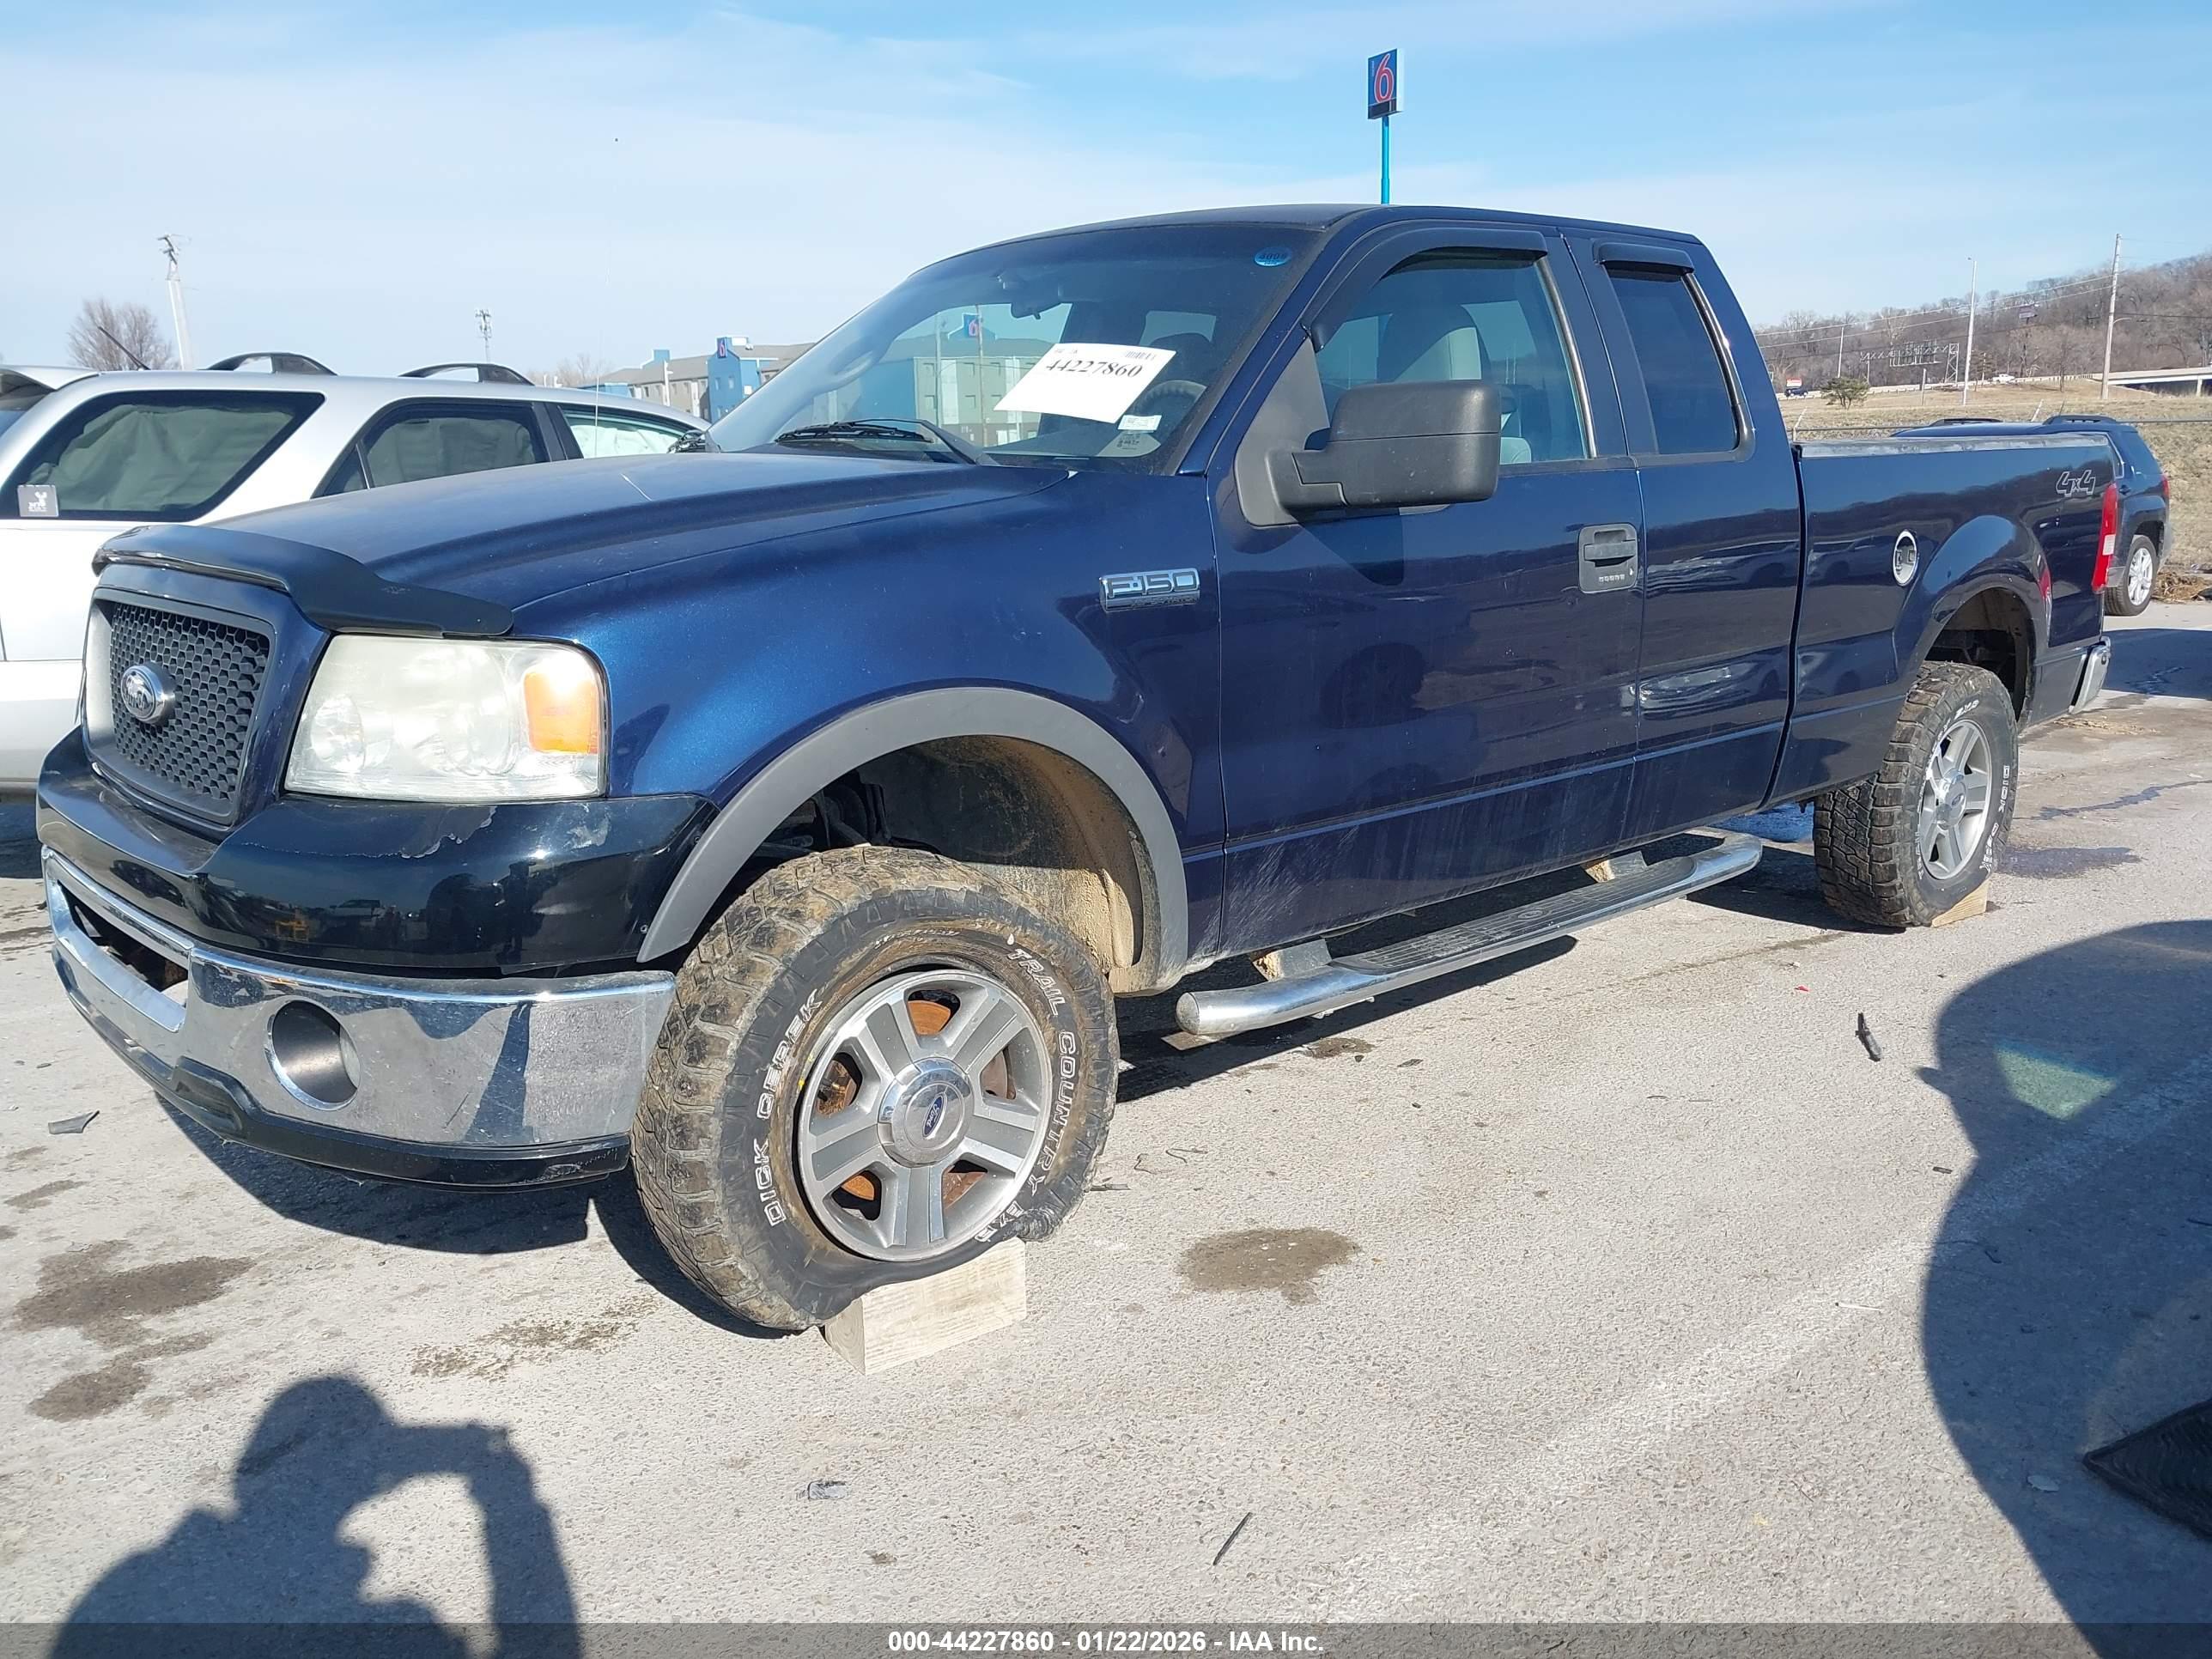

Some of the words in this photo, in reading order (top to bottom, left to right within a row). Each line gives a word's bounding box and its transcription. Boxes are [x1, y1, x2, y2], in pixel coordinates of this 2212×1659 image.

[1374, 53, 1395, 104] 6
[1046, 359, 1143, 378] 44227860
[2055, 469, 2096, 497] 4x4
[1006, 948, 1066, 1017] TRAIL
[1028, 1030, 1077, 1196] COUNTRY
[753, 1138, 787, 1227] DICK
